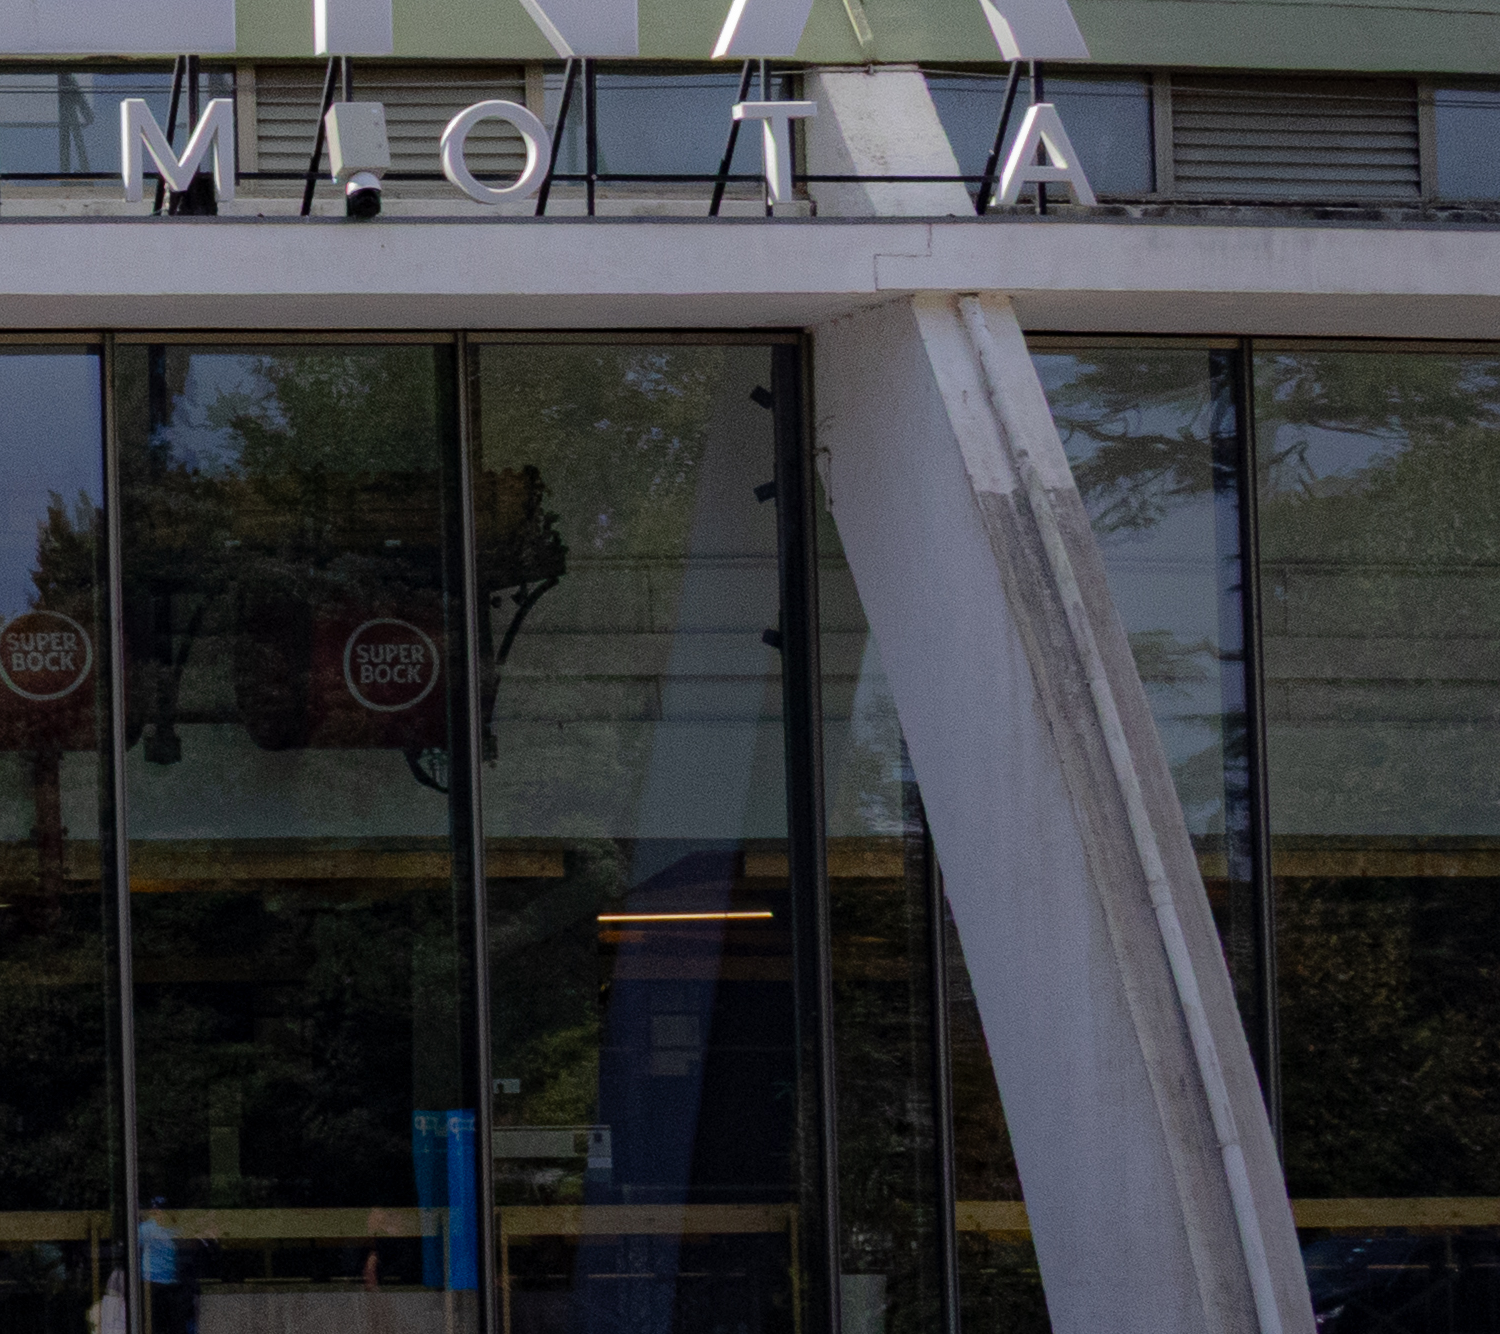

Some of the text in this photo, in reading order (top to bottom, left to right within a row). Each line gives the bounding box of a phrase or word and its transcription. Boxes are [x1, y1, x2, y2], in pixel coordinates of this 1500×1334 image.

[121, 99, 1096, 205] MOTA
[5, 631, 78, 652] SUPER
[11, 651, 76, 672] BOCK
[355, 642, 426, 664] SUPER
[360, 663, 421, 684] BOCK
